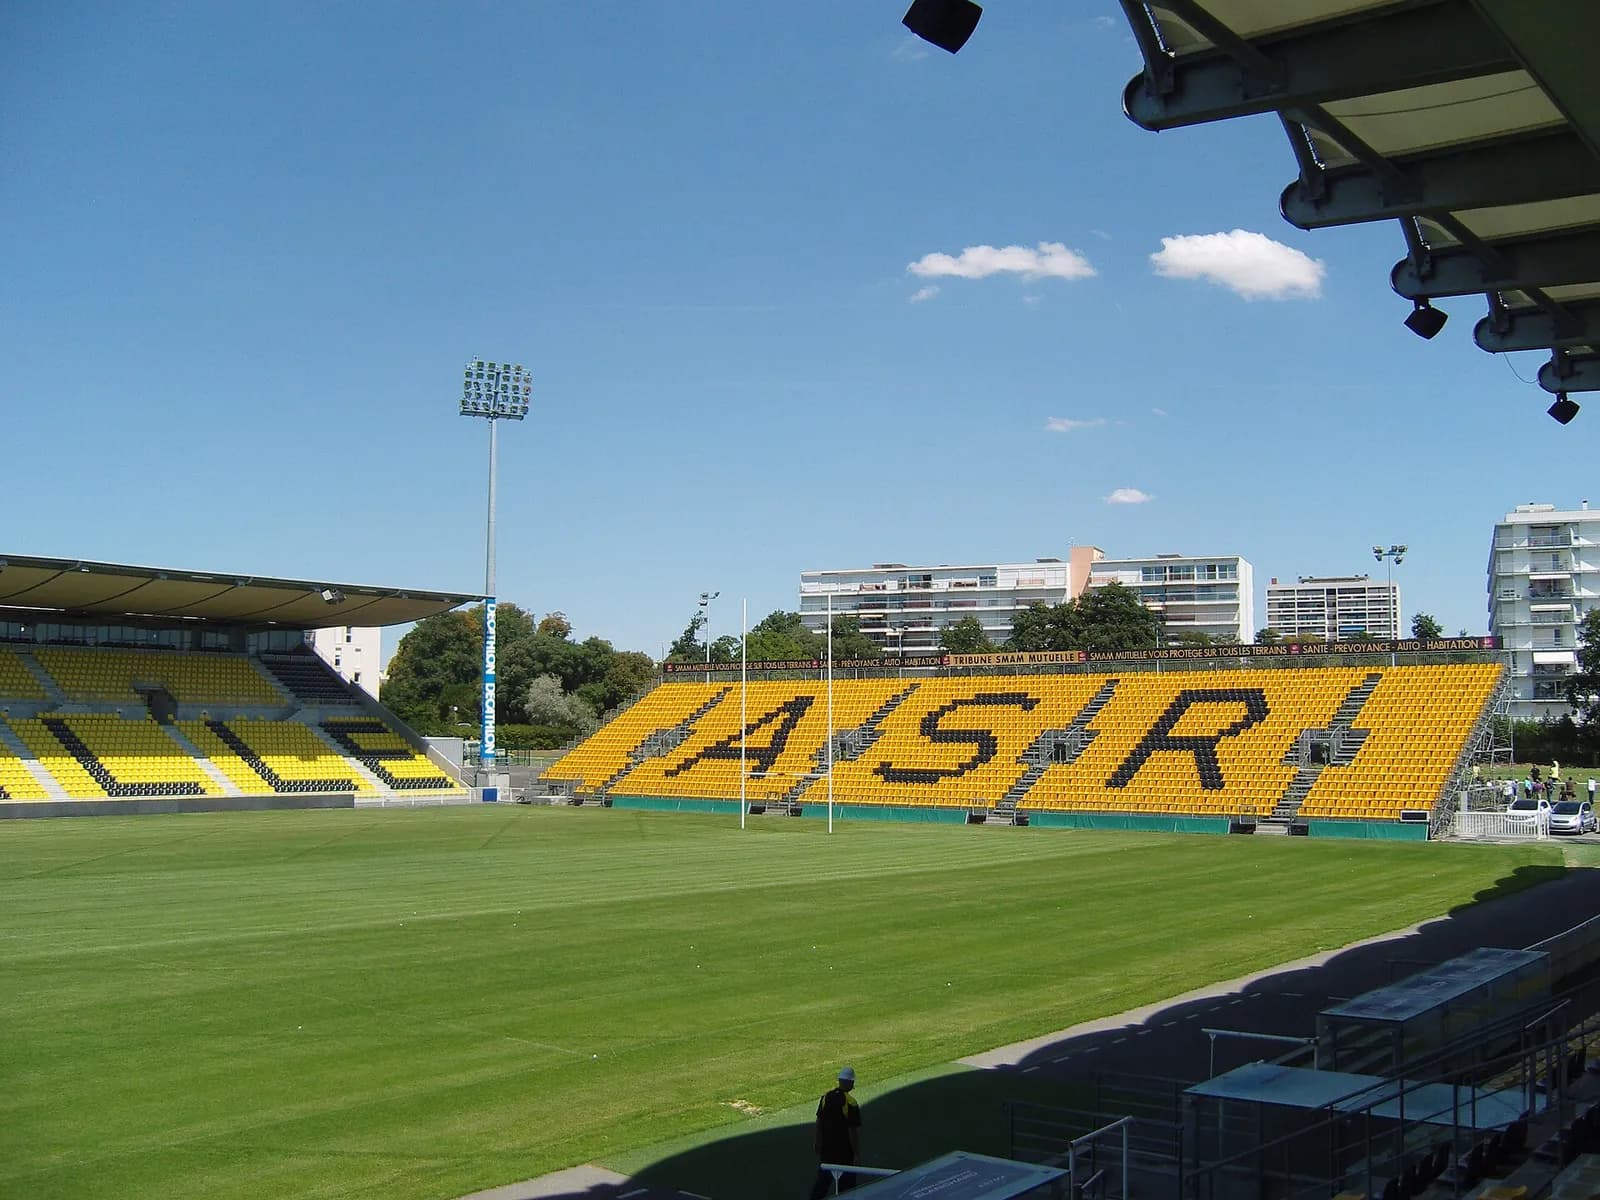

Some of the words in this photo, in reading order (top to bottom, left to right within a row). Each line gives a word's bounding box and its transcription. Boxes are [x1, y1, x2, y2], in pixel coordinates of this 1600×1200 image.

[485, 603, 496, 675] DECATHLON
[1397, 641, 1420, 651] AUTO
[1426, 640, 1478, 650] HABITATION
[1090, 651, 1114, 660] SMAM
[1115, 650, 1148, 660] MUTUELLE
[1148, 649, 1168, 658] VOUS
[1203, 648, 1217, 657] SUR
[1219, 647, 1238, 656] TOUS
[1239, 646, 1251, 655] LES
[1251, 645, 1287, 655] TERRAINS
[884, 658, 900, 667] AUTO
[904, 657, 940, 666] HABITATION
[954, 655, 992, 665] TRIBUNE
[996, 654, 1024, 664] SMAM
[1028, 653, 1075, 663] MUTUELLE
[714, 663, 730, 671] VOUS
[730, 662, 753, 670] PROTGE
[753, 661, 762, 670] SUR
[763, 661, 777, 669] TOUS
[777, 661, 786, 669] LES
[786, 661, 811, 669] TERRAINS
[484, 683, 496, 754] DECATHLON
